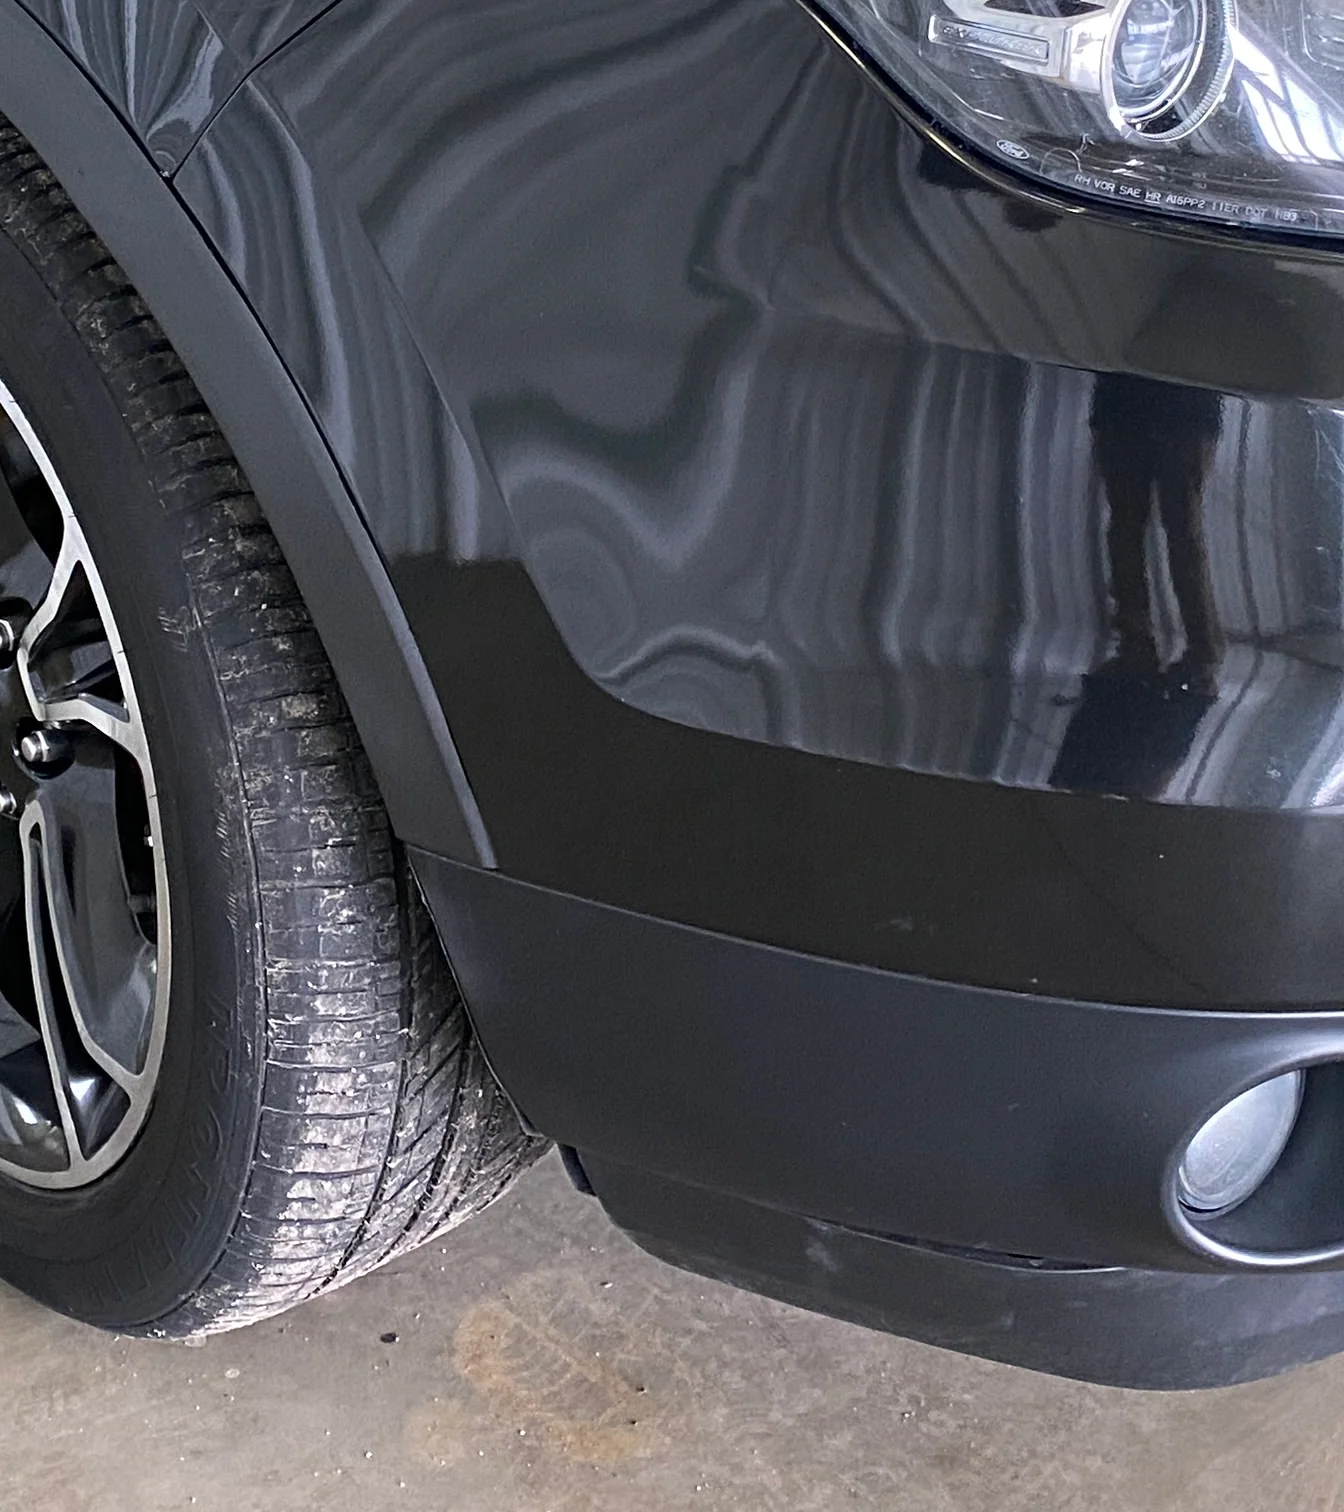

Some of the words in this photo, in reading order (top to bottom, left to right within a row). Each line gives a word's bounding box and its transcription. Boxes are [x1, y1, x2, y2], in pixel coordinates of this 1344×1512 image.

[1074, 173, 1091, 186] RH
[1094, 179, 1116, 193] VOR
[1119, 185, 1142, 198] SAE
[1145, 191, 1162, 204] HR
